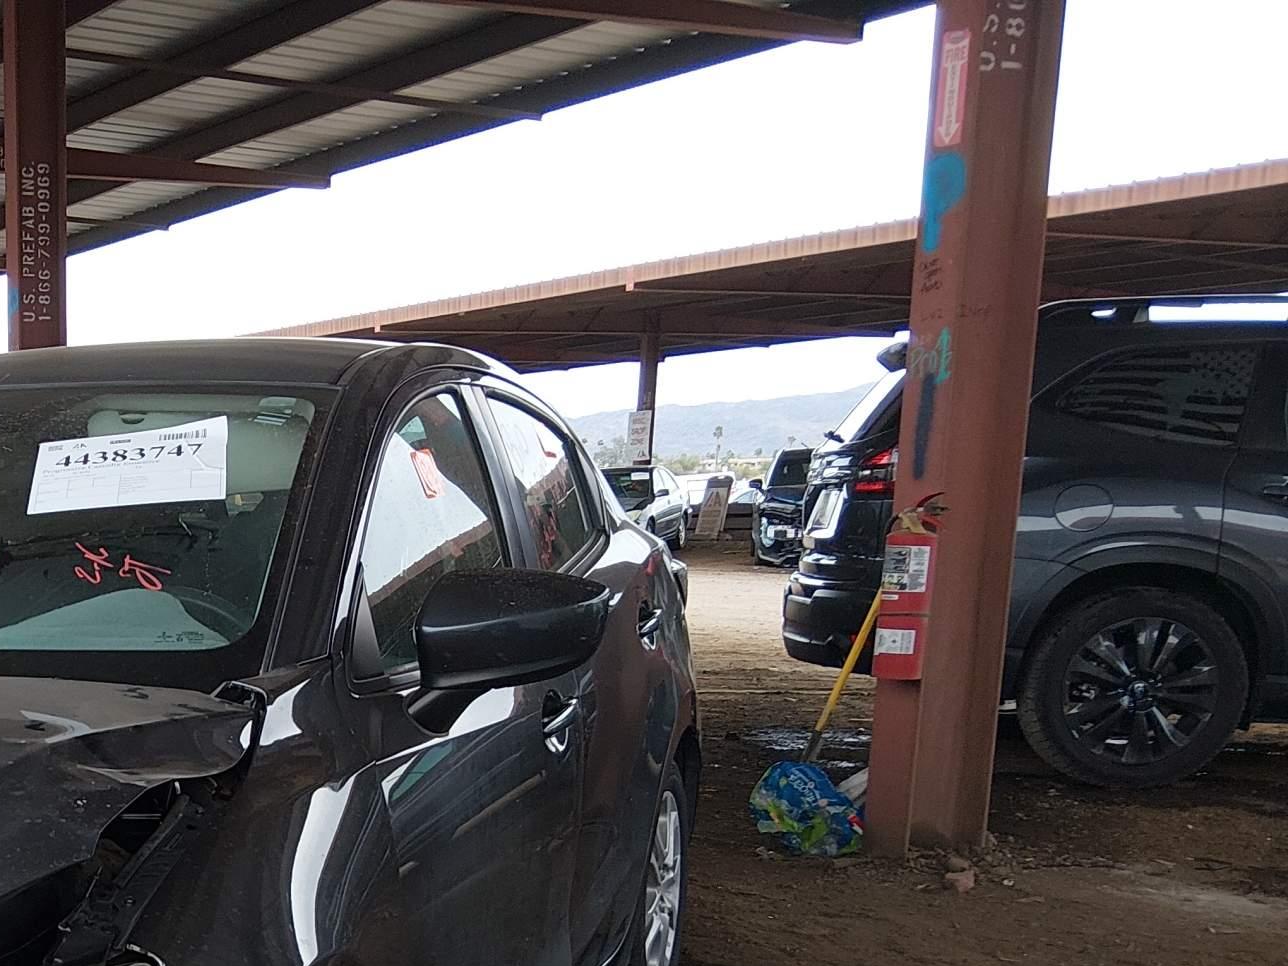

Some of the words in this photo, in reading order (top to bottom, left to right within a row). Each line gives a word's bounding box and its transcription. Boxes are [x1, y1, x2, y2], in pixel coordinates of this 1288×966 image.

[21, 161, 35, 196] INC.
[21, 206, 36, 277] PREFAB
[37, 163, 52, 321] 1-866-799-0969
[22, 288, 36, 322] U.S.
[55, 442, 204, 467] 44383747
